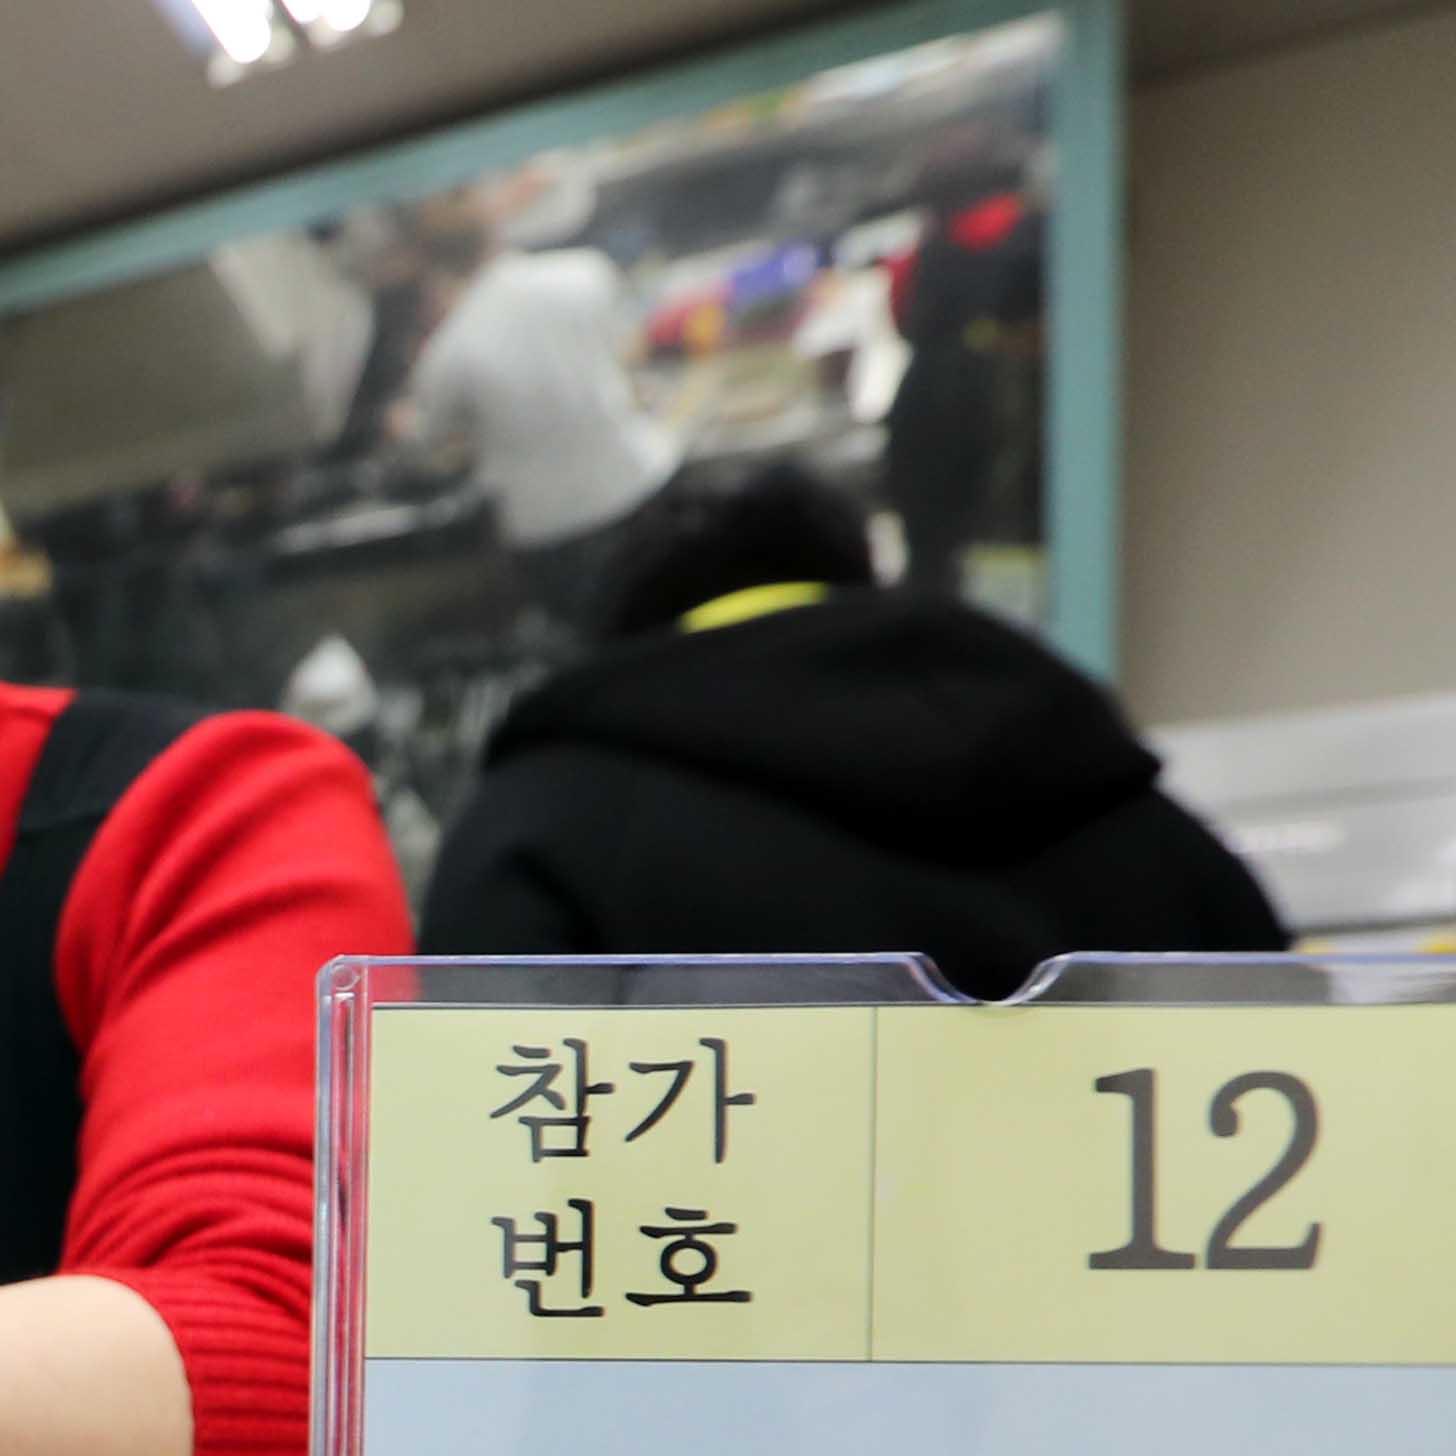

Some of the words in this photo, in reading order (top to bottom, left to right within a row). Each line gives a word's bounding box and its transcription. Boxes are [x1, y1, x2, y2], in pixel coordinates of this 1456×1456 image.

[489, 1037, 757, 1165] 참가
[1087, 1067, 1324, 1271] 12
[491, 1198, 754, 1319] 번호
